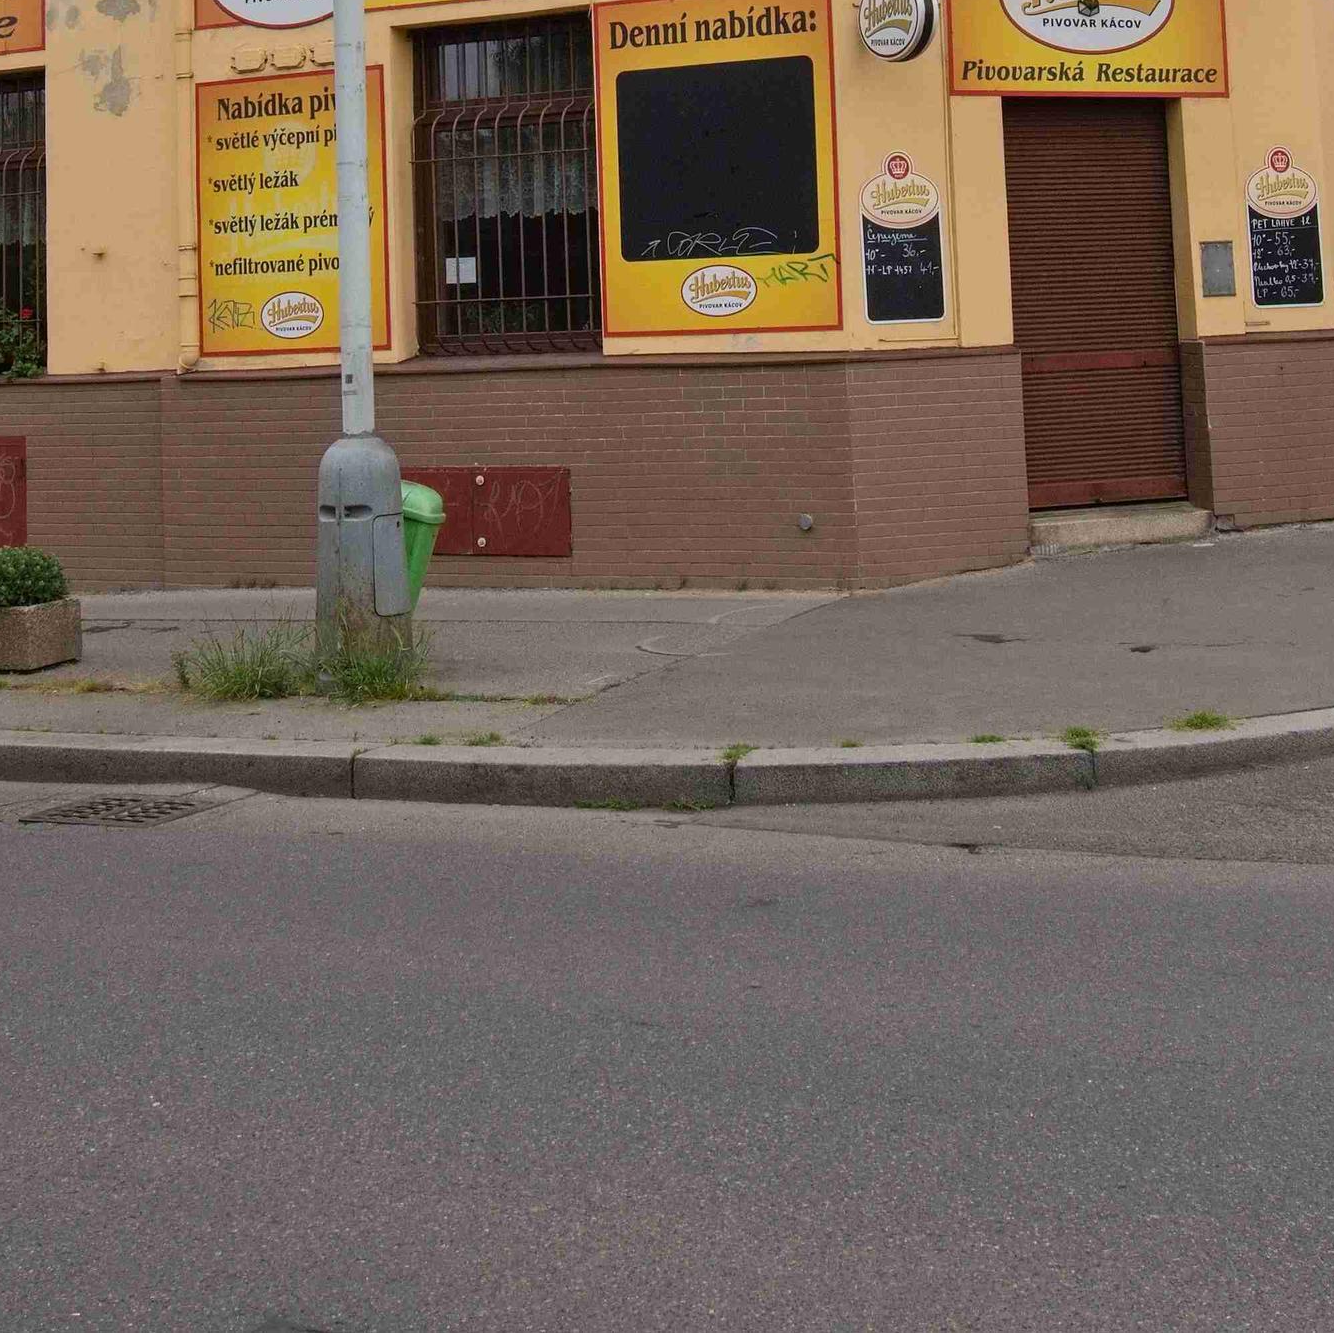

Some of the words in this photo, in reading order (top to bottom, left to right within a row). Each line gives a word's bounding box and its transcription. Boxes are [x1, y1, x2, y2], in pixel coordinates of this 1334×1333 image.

[609, 12, 687, 50] Denní
[694, 5, 817, 42] nabídka:
[1042, 17, 1097, 28] PIVOVAR
[1100, 17, 1142, 29] KÁCOV
[962, 59, 1085, 82] Pivovarská
[1096, 63, 1217, 84] Restaurace
[217, 91, 303, 121] Nabídka
[215, 131, 259, 151] světlé
[263, 125, 320, 151] výčepní
[259, 170, 299, 190] ležák
[870, 179, 930, 207] Hubertus
[1255, 174, 1309, 200] Hubertus
[260, 211, 299, 232] ležák
[1251, 218, 1267, 229] PET
[308, 252, 340, 277] pivo
[689, 269, 752, 302] Hubertus
[267, 297, 318, 325] Hubertus
